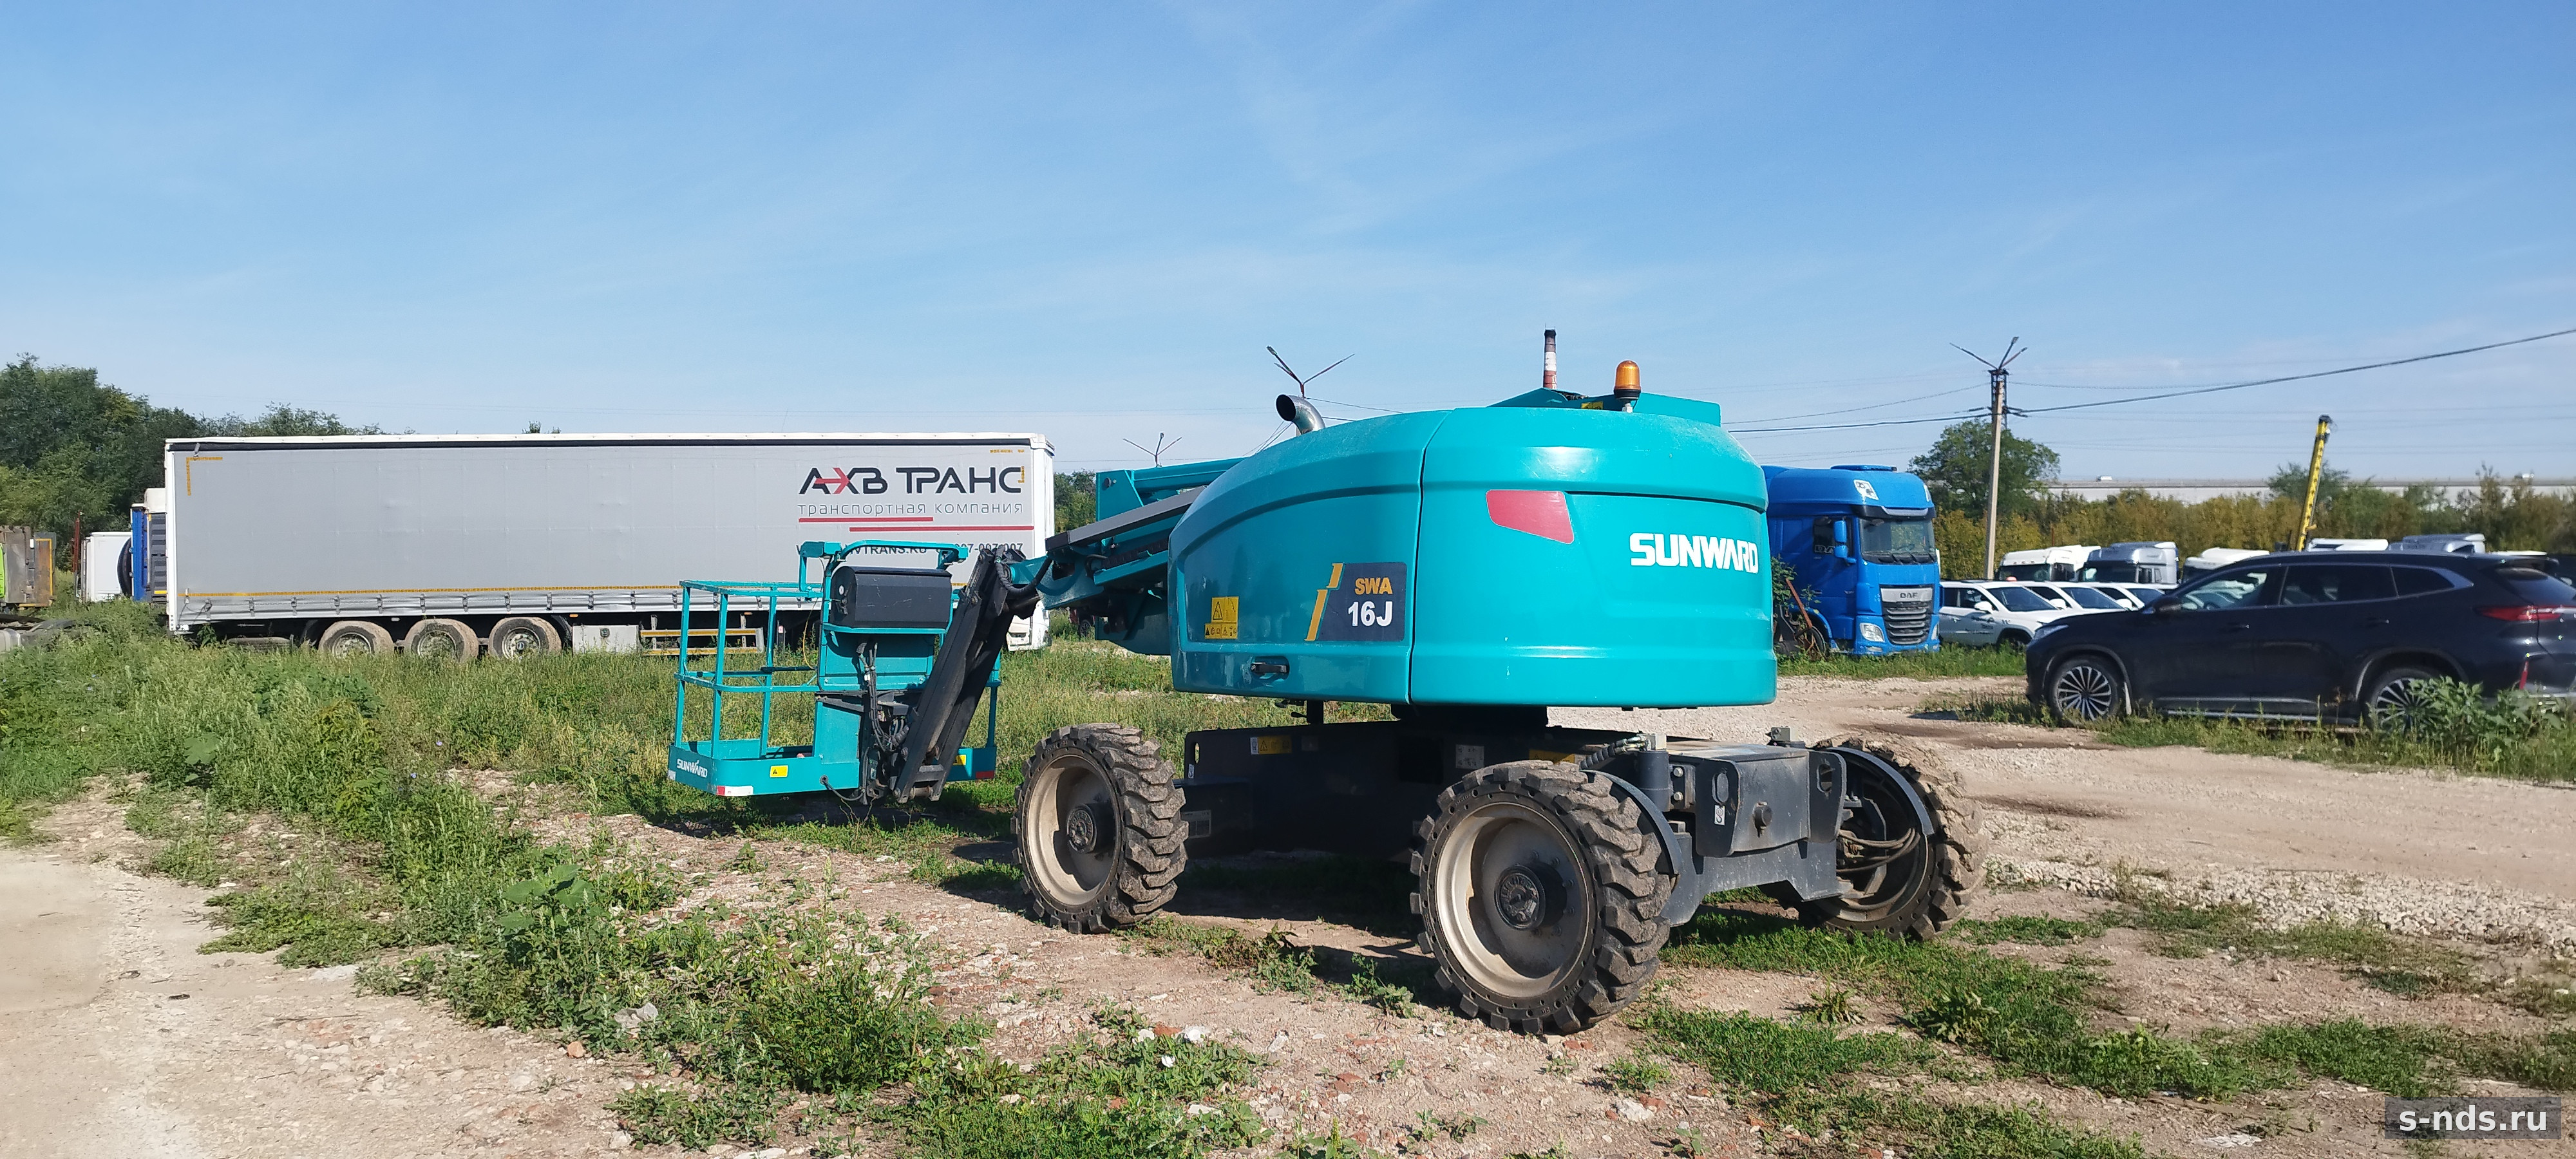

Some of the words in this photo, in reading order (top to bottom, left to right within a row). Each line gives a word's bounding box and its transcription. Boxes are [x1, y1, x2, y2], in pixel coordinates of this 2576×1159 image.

[895, 467, 1022, 494] ТРАНС
[797, 504, 925, 516] транспортная
[934, 503, 1023, 513] компания
[1629, 532, 1759, 574] SUNWARD
[1354, 577, 1393, 595] SWA
[1348, 601, 1393, 627] 16J
[676, 759, 708, 778] SUNWARD
